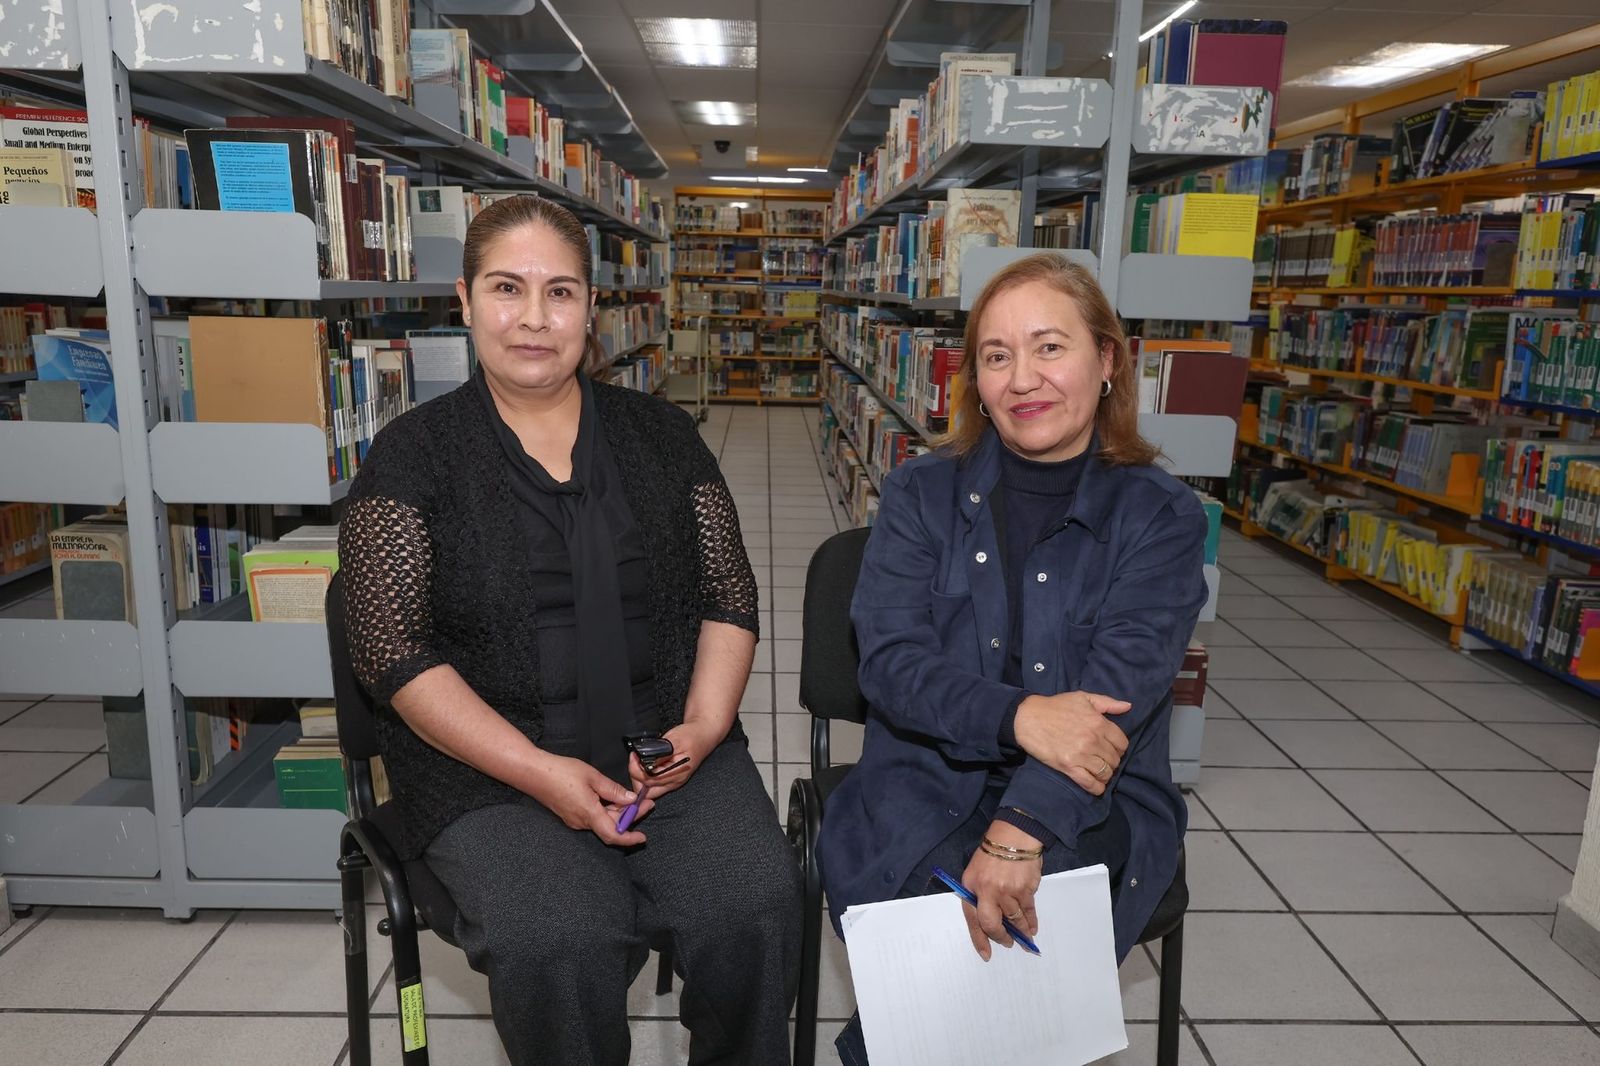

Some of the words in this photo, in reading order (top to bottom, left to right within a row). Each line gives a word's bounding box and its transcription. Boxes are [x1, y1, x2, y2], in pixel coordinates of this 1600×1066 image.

[22, 126, 45, 136] Global
[46, 127, 88, 139] Perspectives
[4, 139, 23, 149] Small
[24, 140, 38, 149] and
[39, 141, 66, 150] Medium
[3, 166, 49, 178] Pequeños
[51, 535, 61, 543] LA
[61, 535, 94, 544] EMPRESA
[52, 542, 108, 551] MULTINACIONAL
